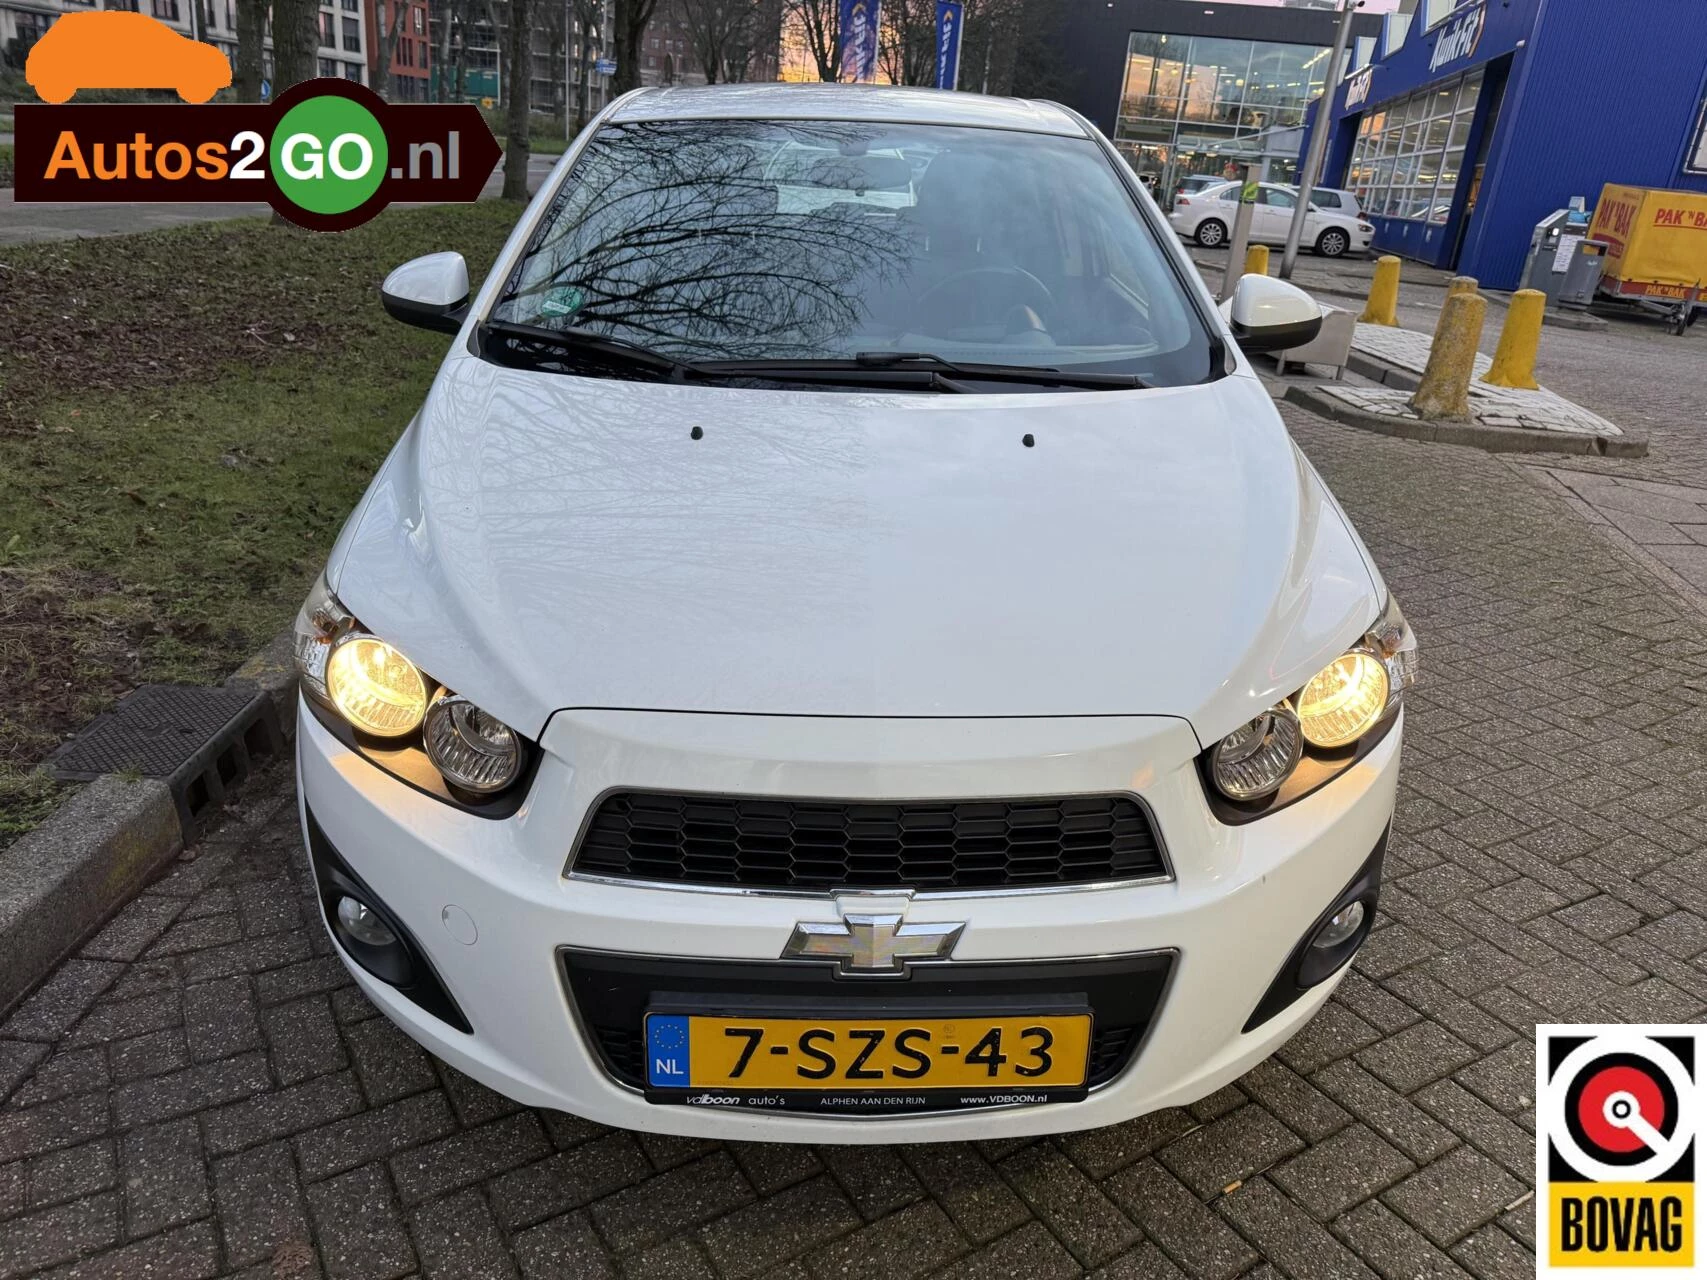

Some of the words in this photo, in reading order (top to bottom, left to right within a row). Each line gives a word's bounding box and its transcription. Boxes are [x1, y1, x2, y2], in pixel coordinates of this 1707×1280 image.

[1654, 208, 1686, 224] PAK
[724, 1027, 1054, 1079] 7-SZS-43
[656, 1059, 684, 1075] NL
[748, 1095, 786, 1105] auto's
[883, 1097, 903, 1105] DEN
[906, 1097, 926, 1105] RIJN
[960, 1095, 1048, 1104] www.VDBOON.nl
